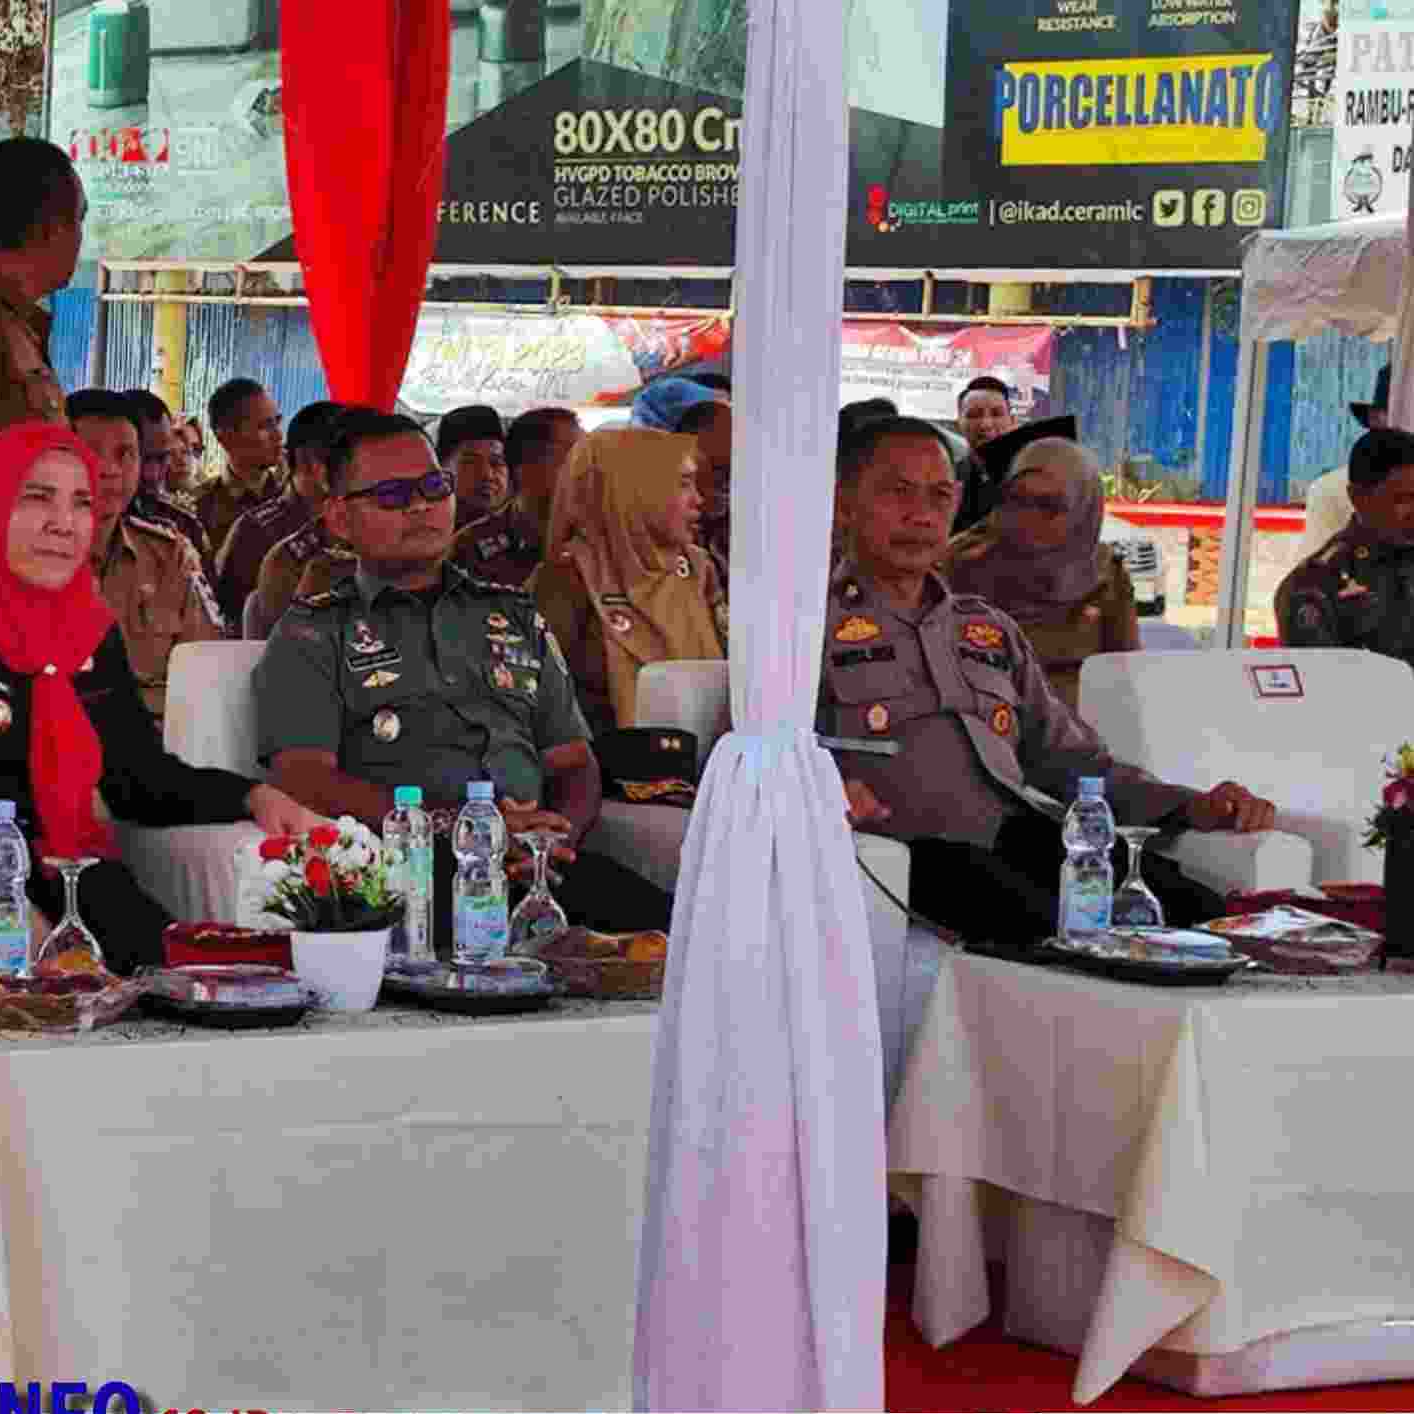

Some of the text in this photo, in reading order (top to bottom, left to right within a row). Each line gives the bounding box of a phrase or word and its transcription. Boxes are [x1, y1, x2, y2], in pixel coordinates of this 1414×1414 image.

[1037, 15, 1114, 31] RESISTANCE
[994, 63, 1281, 140] PORCELLANATO
[554, 108, 685, 153] 80X80
[614, 163, 691, 182] TOBACCO
[553, 185, 642, 207] GLAZED
[999, 200, 1143, 223] @ikad.ceramic
